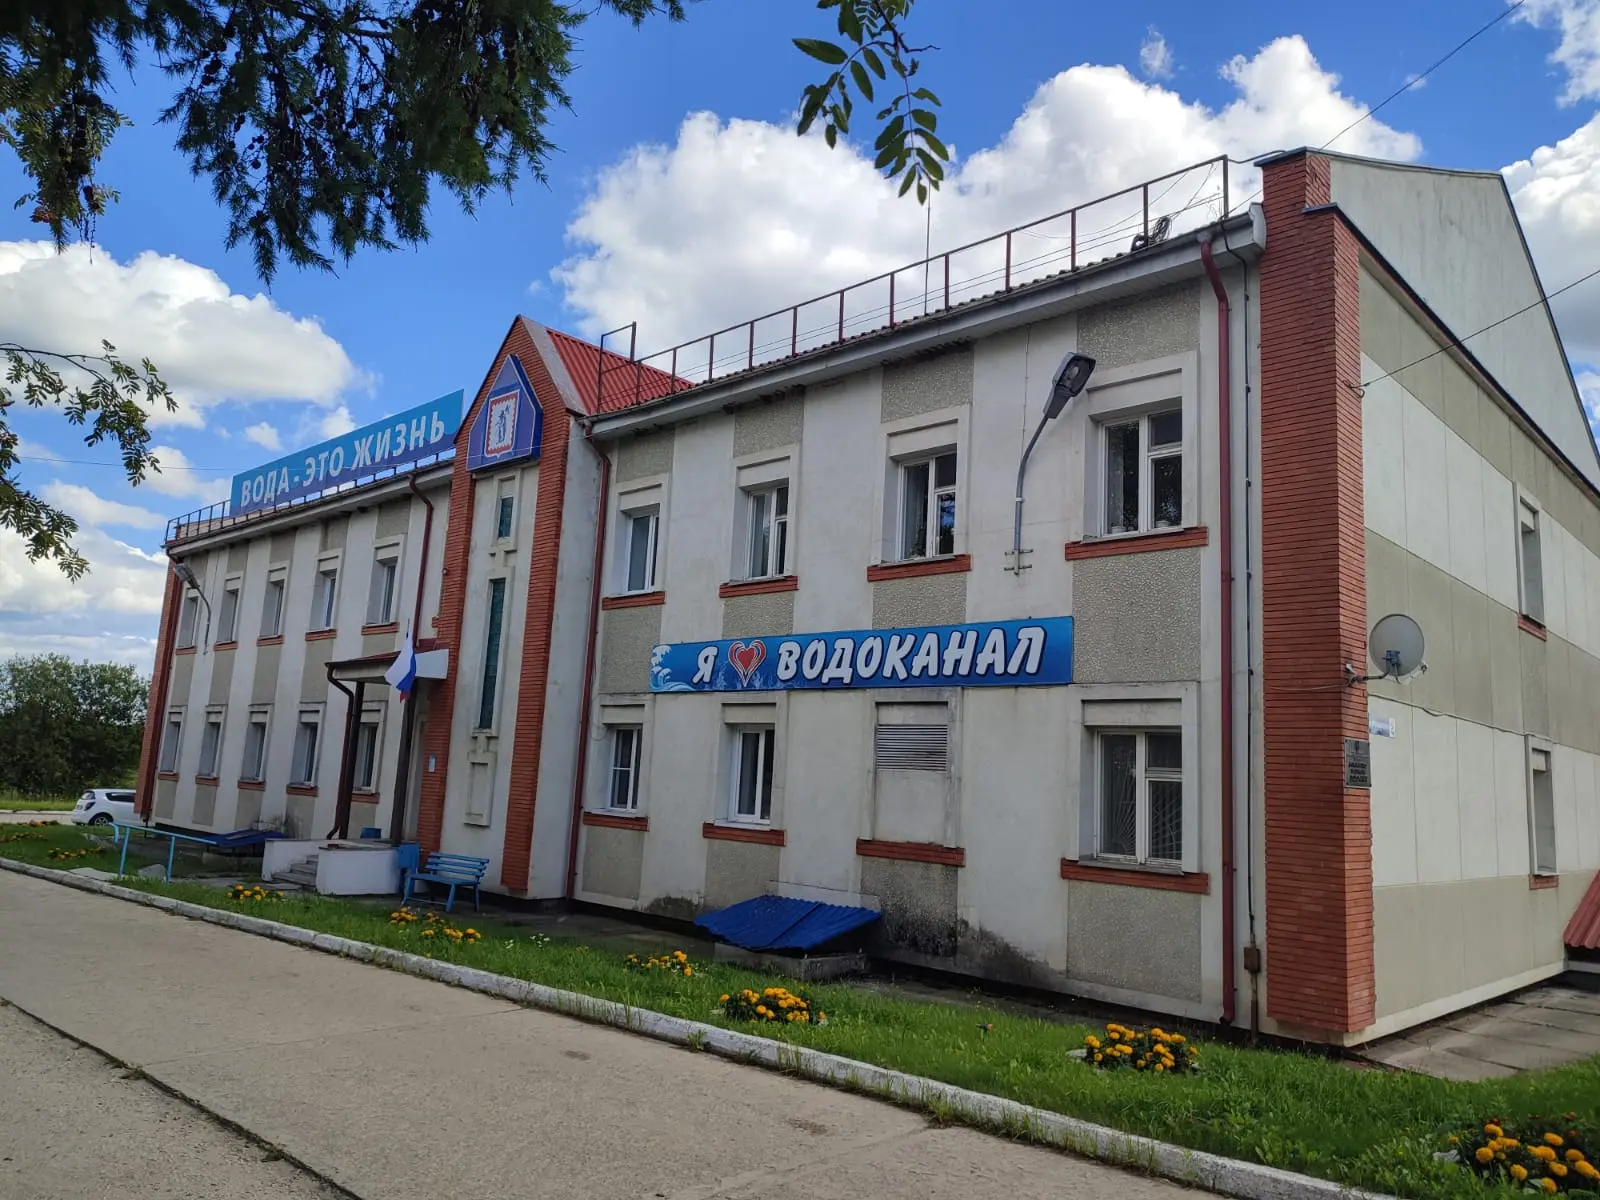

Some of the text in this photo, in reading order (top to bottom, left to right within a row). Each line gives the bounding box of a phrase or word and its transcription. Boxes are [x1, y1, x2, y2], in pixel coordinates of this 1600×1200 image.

[241, 466, 290, 507] ВОДА
[303, 446, 345, 488] ЭТО
[351, 411, 445, 471] ЖИЗНЬ
[692, 626, 1047, 685] Я ВОДОКАНАЛ
